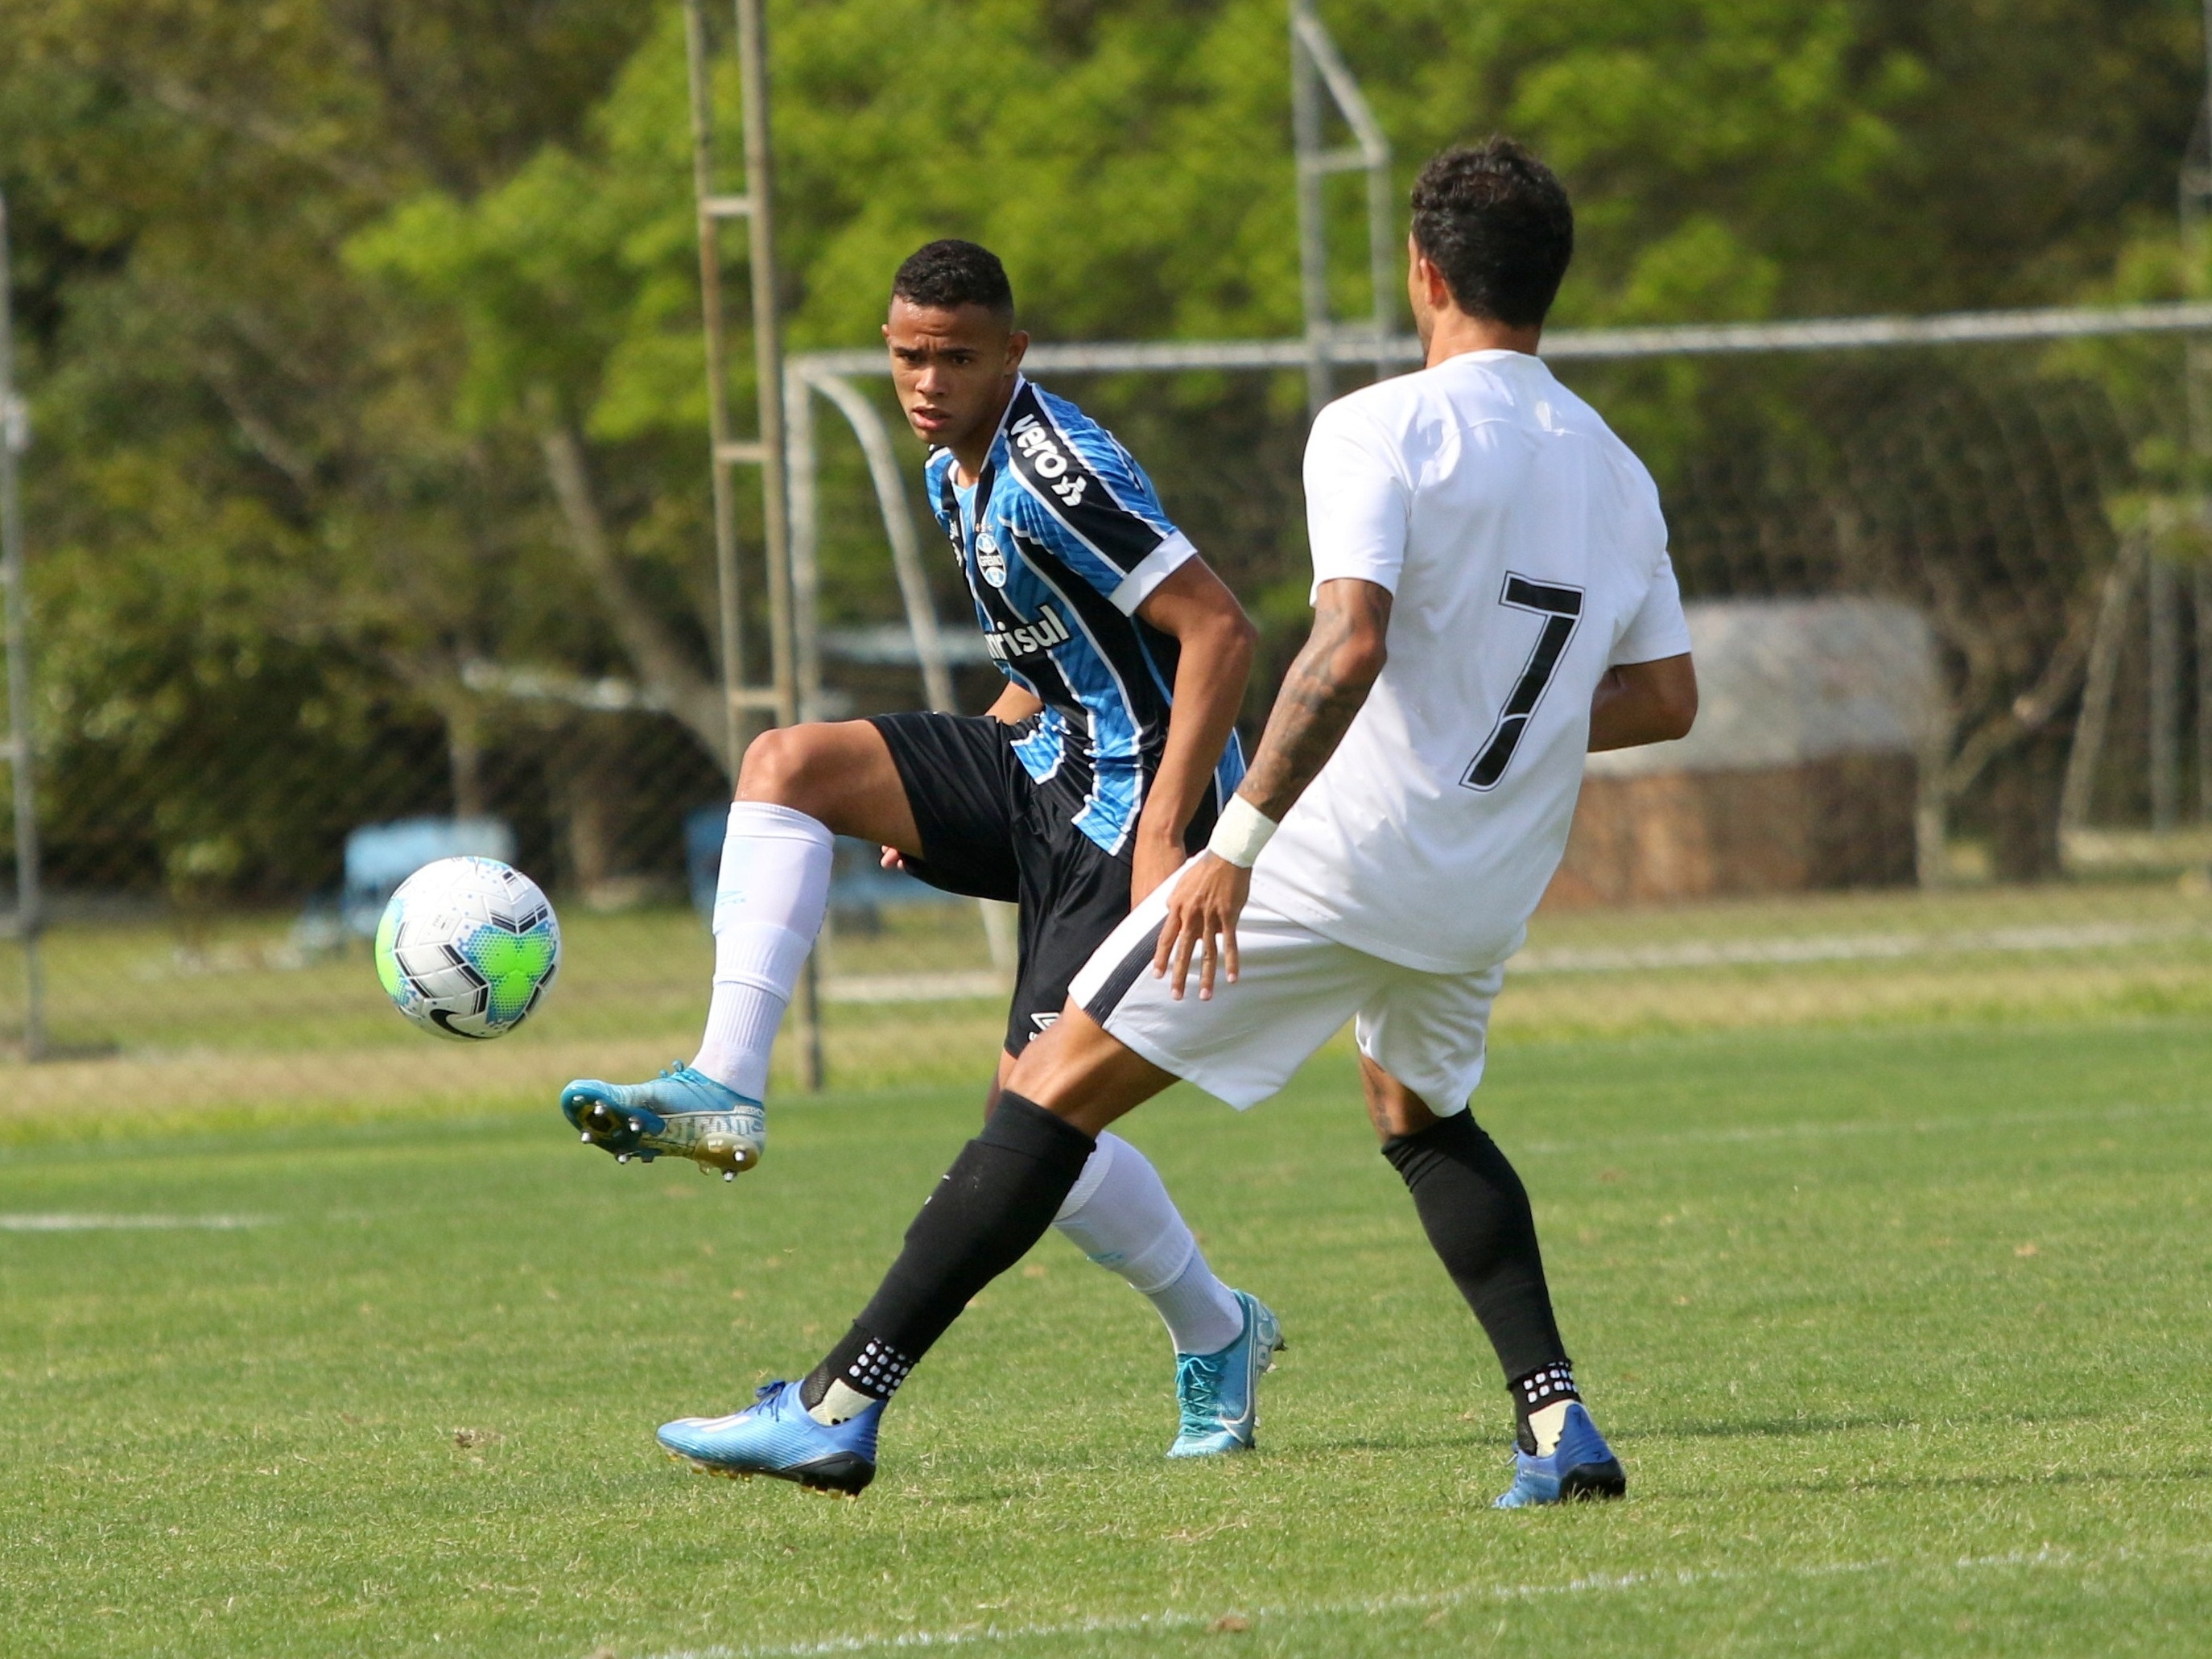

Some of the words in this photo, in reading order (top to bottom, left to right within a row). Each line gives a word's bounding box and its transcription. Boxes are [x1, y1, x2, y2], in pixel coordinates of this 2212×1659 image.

[1011, 413, 1067, 478] vero
[984, 605, 1070, 659] nrisul
[1459, 570, 1585, 792] 7
